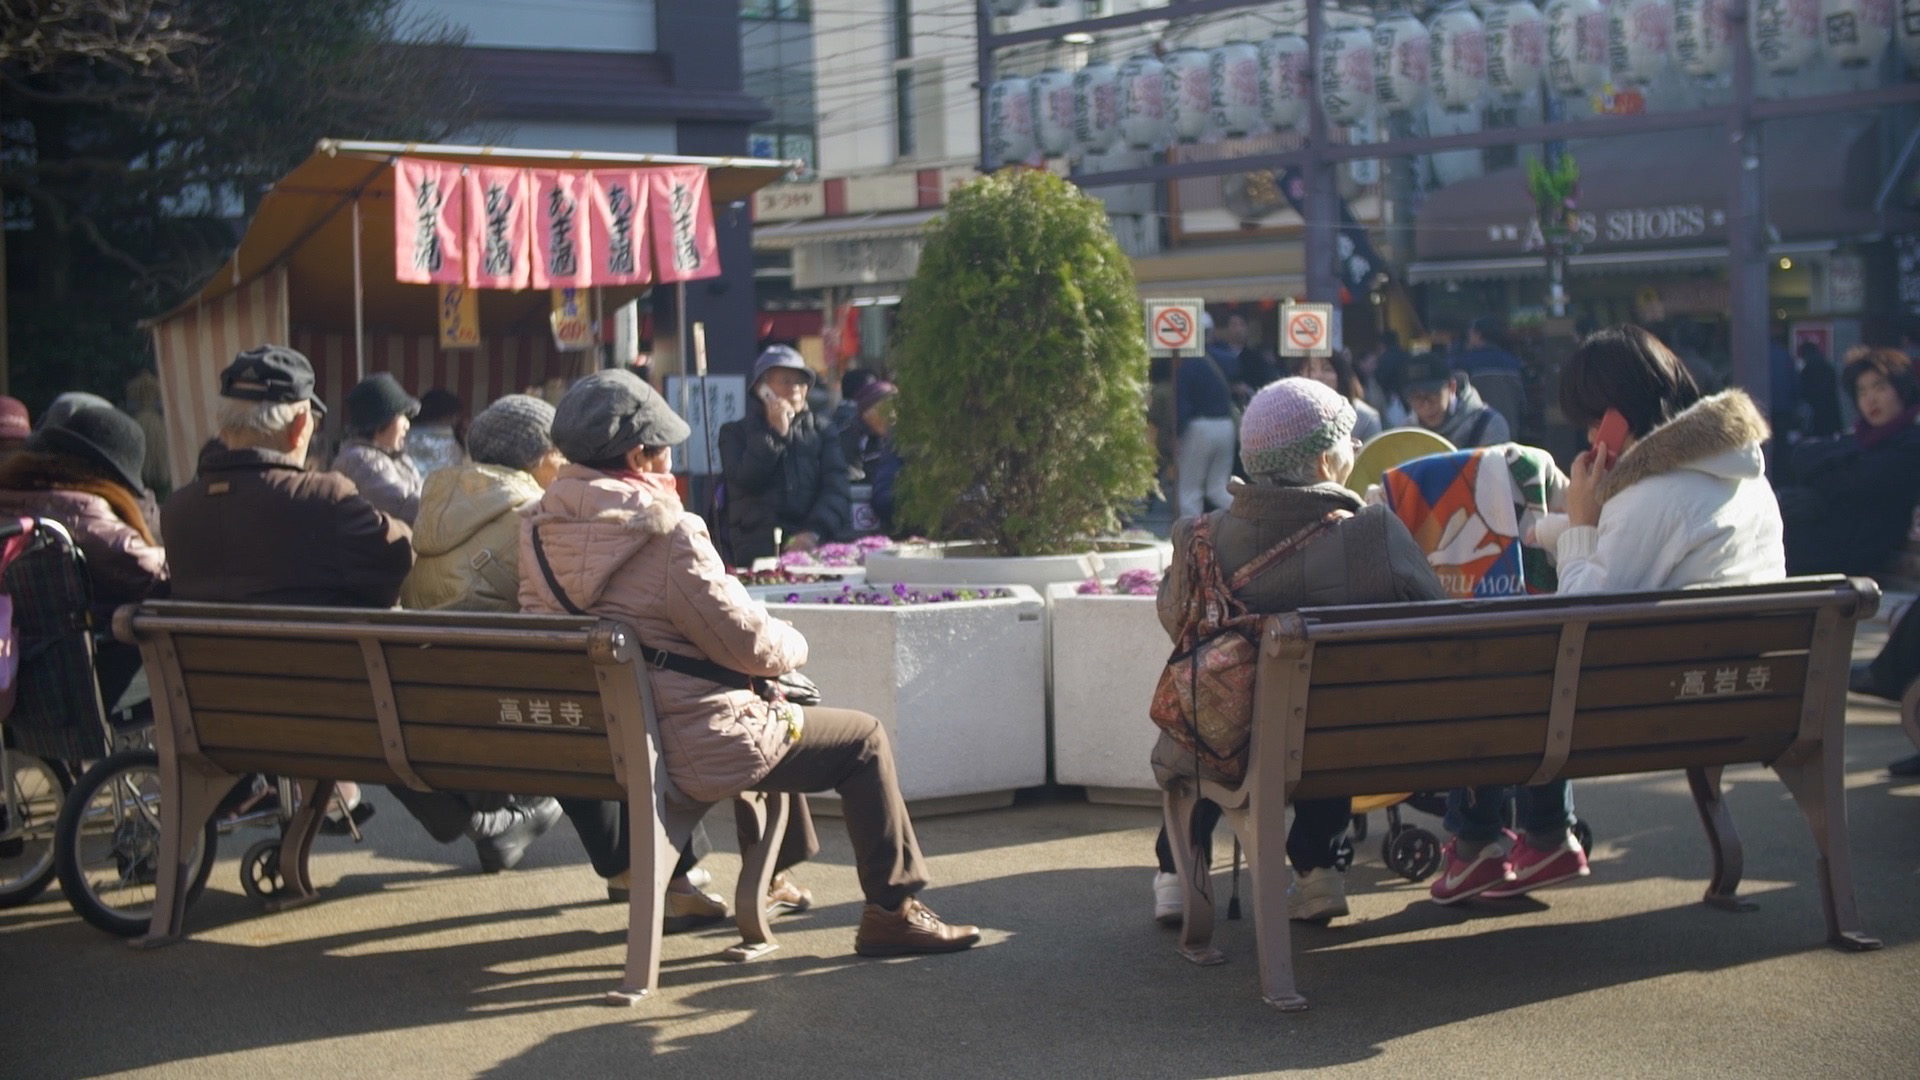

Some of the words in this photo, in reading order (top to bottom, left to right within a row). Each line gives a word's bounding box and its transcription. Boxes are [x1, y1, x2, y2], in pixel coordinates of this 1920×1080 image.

[1605, 204, 1706, 242] SHOES
[1681, 665, 1771, 696] 高岩寺
[498, 698, 584, 727] 高岩寺
